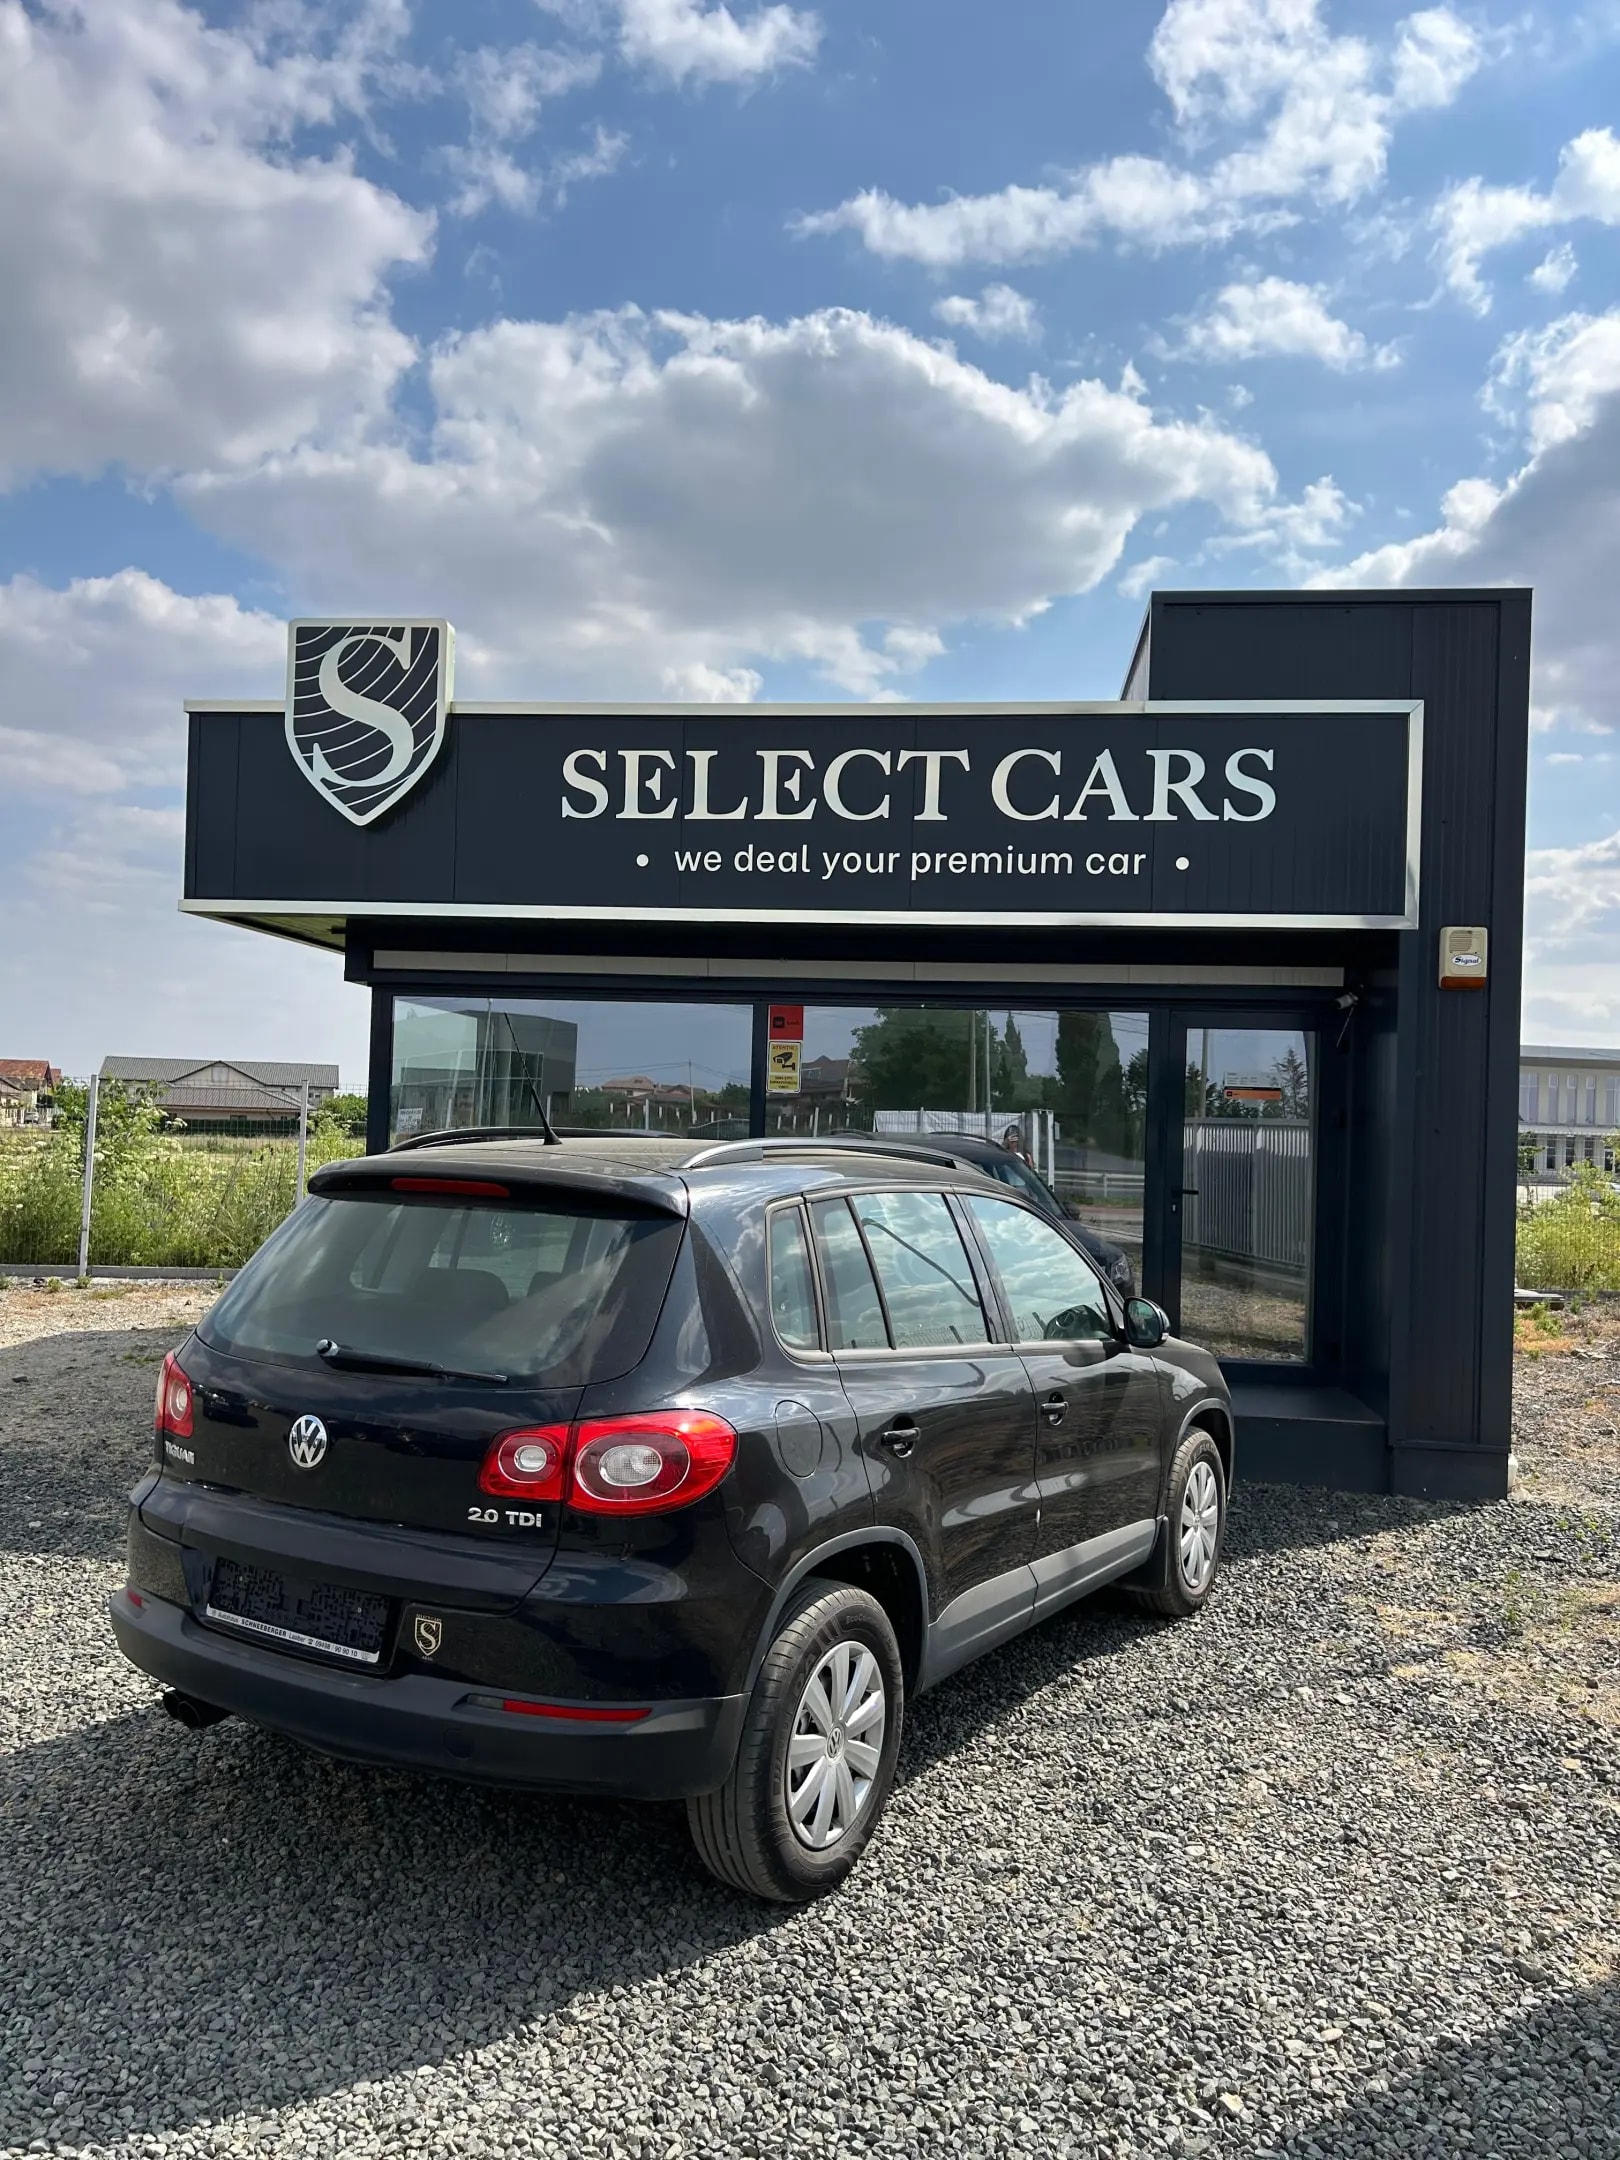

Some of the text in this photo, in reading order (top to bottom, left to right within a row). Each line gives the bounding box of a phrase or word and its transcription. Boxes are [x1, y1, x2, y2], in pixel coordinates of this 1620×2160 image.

[313, 627, 414, 788] S
[561, 748, 1277, 822] SELECT CARS
[674, 843, 1147, 883] we deal your premium car
[1454, 956, 1479, 965] Signal
[165, 1440, 195, 1465] TIGUAN
[289, 1414, 328, 1469] VW
[505, 1510, 542, 1528] TDI
[241, 1618, 287, 1637] SCHNEEBERGER
[334, 1645, 342, 1653] 90
[420, 1622, 436, 1650] S
